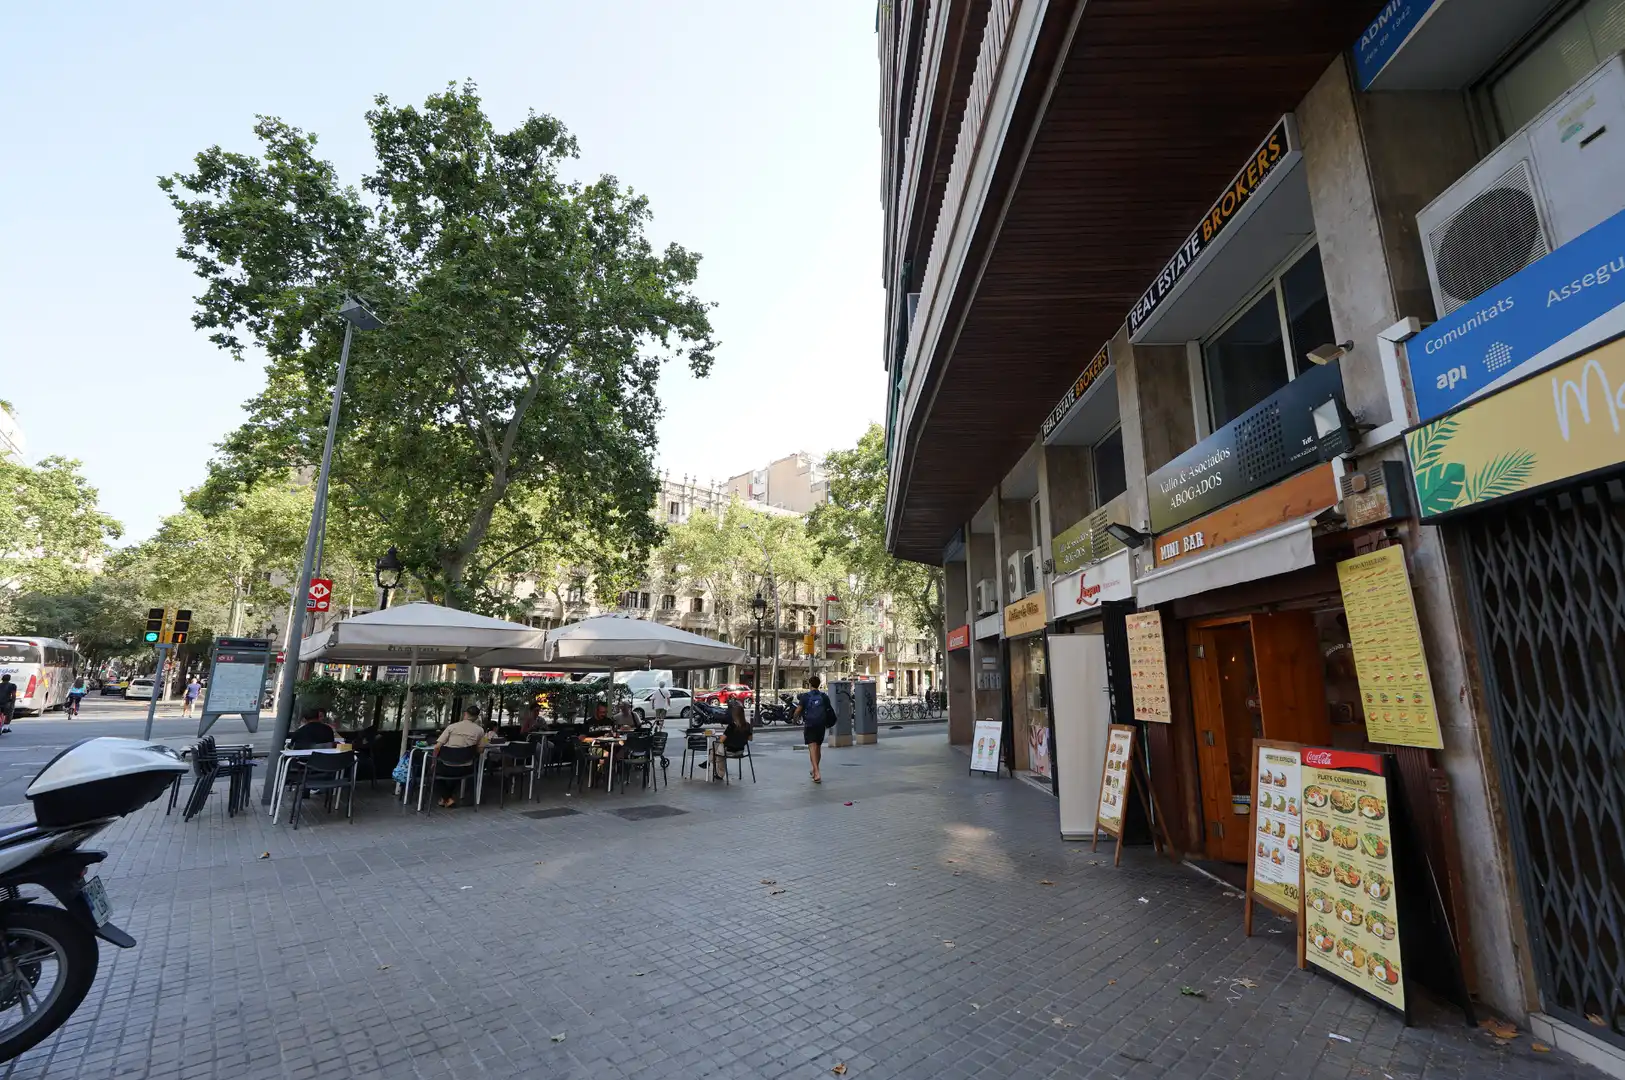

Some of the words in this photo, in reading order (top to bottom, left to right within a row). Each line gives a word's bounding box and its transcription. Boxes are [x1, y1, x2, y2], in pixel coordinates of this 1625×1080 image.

[1130, 289, 1157, 329] REAL
[1157, 232, 1200, 296] ESTATE
[1202, 134, 1281, 242] BROKERS
[1425, 297, 1516, 357] Comunitats
[1043, 415, 1056, 437] REAL
[1056, 390, 1076, 420] ESTATE
[1075, 350, 1109, 396] BROKERS
[1435, 364, 1467, 391] api
[1179, 472, 1188, 485] &
[1187, 447, 1232, 482] Asociados
[1169, 471, 1223, 510] ABOGADOS
[1159, 538, 1181, 561] MINI
[1183, 531, 1206, 553] BAR
[314, 586, 325, 595] M
[1333, 776, 1367, 787] COMBINATS
